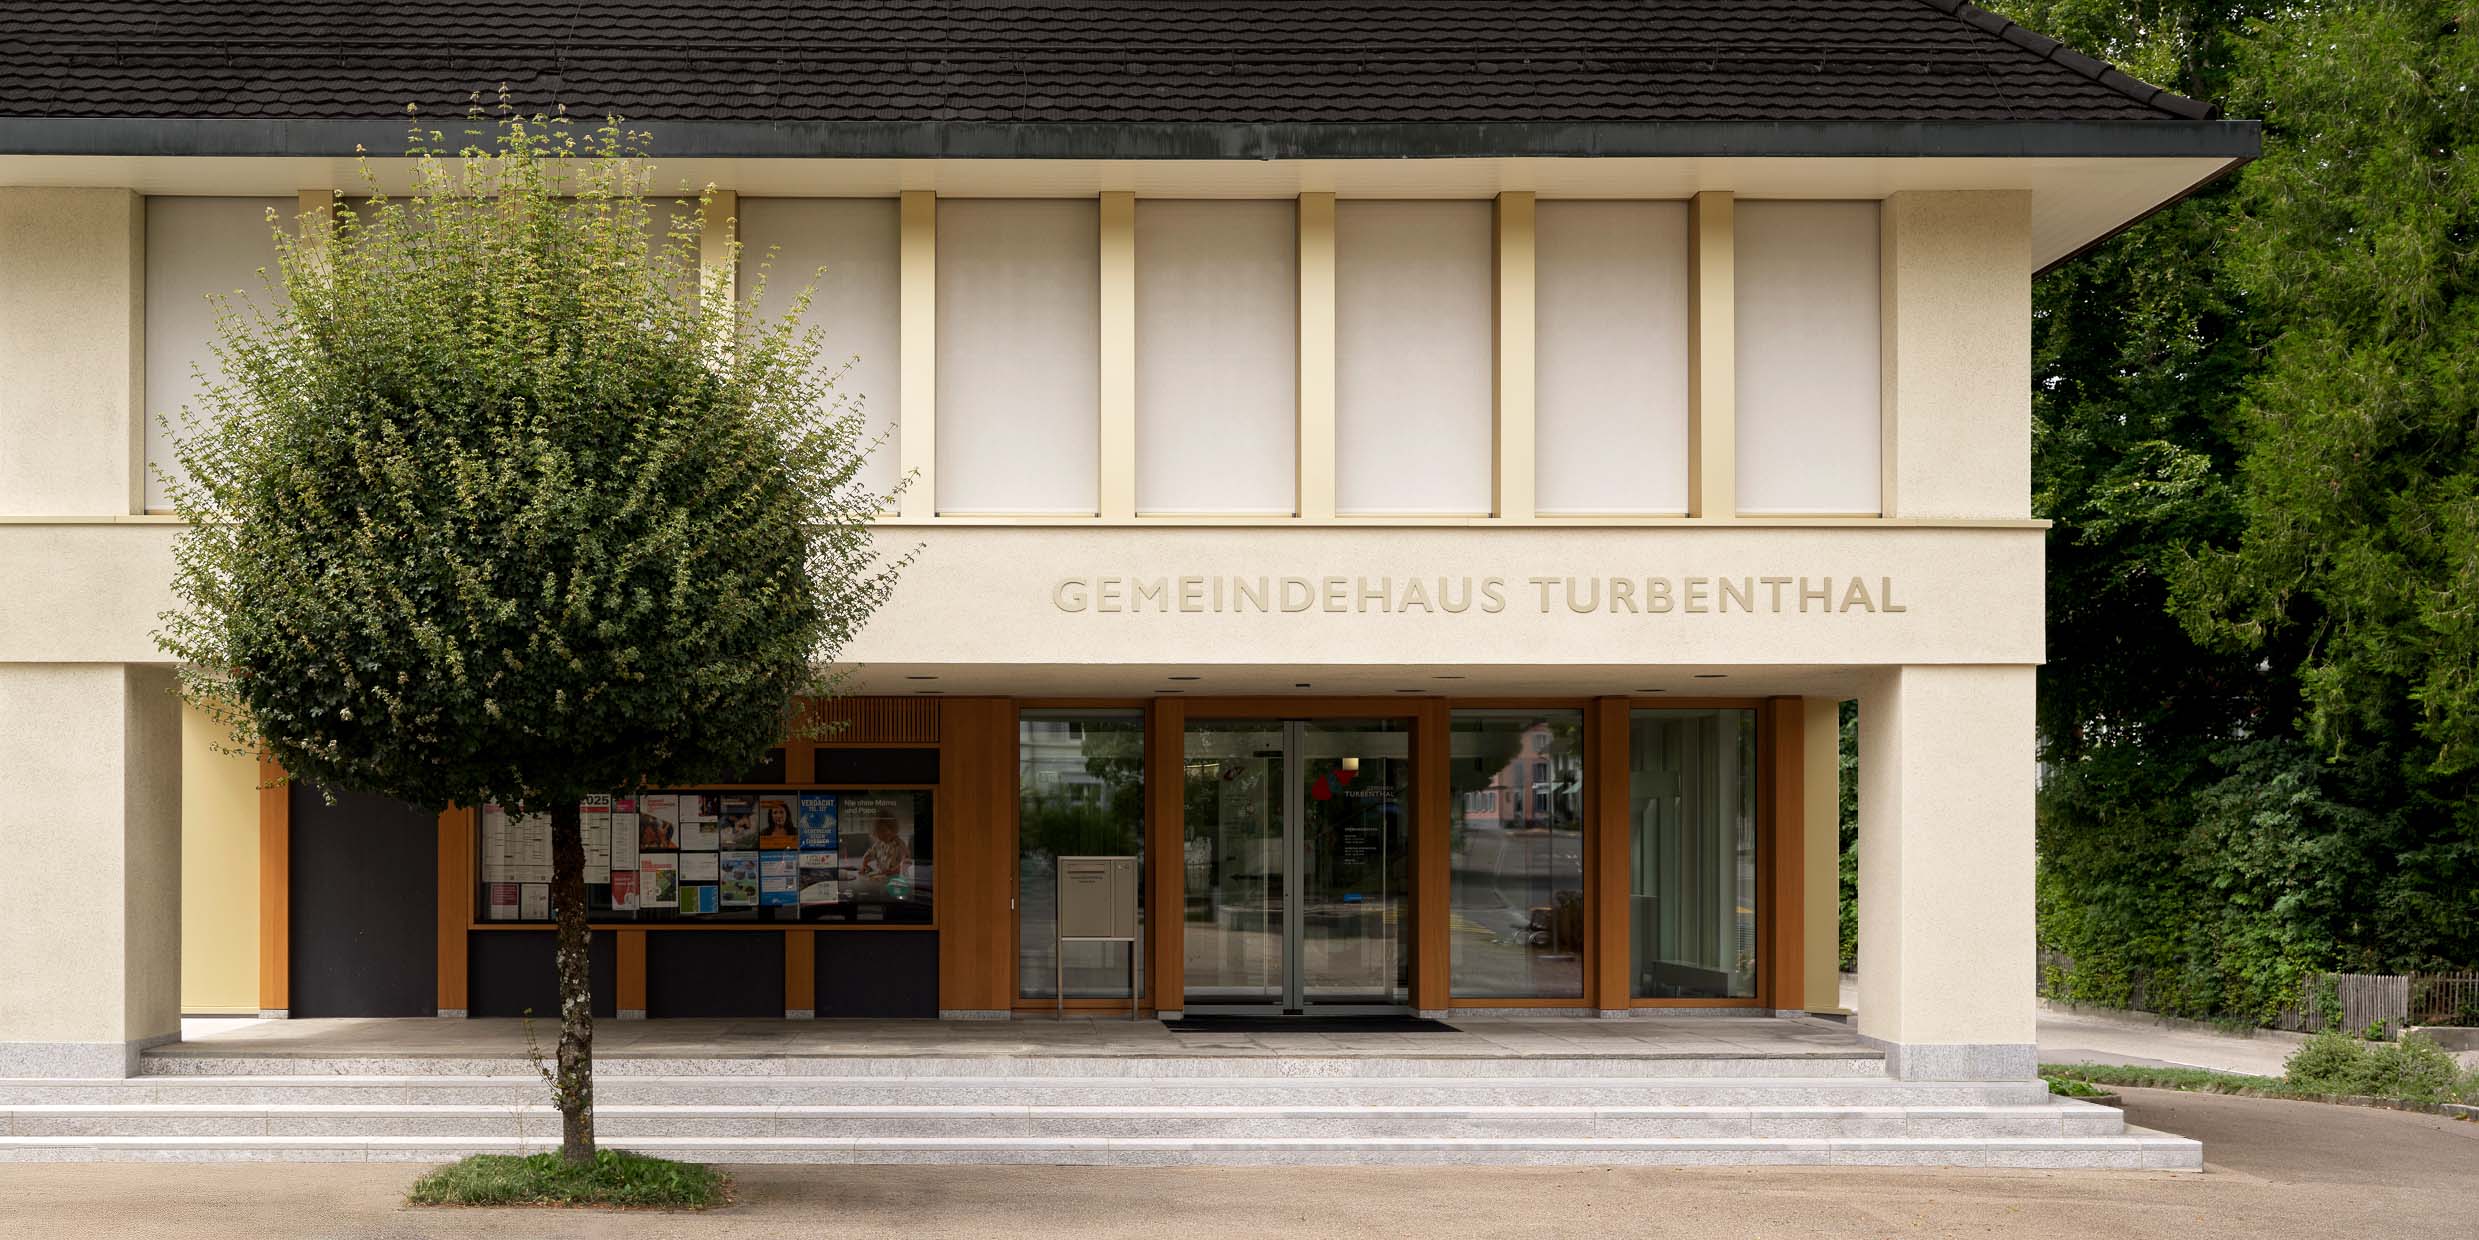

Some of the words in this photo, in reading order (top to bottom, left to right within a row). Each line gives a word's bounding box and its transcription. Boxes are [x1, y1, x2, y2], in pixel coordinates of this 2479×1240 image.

[1052, 576, 1506, 613] GEMEINDEHAUS
[1528, 576, 1907, 614] TURBENTHAL
[580, 795, 609, 805] 025
